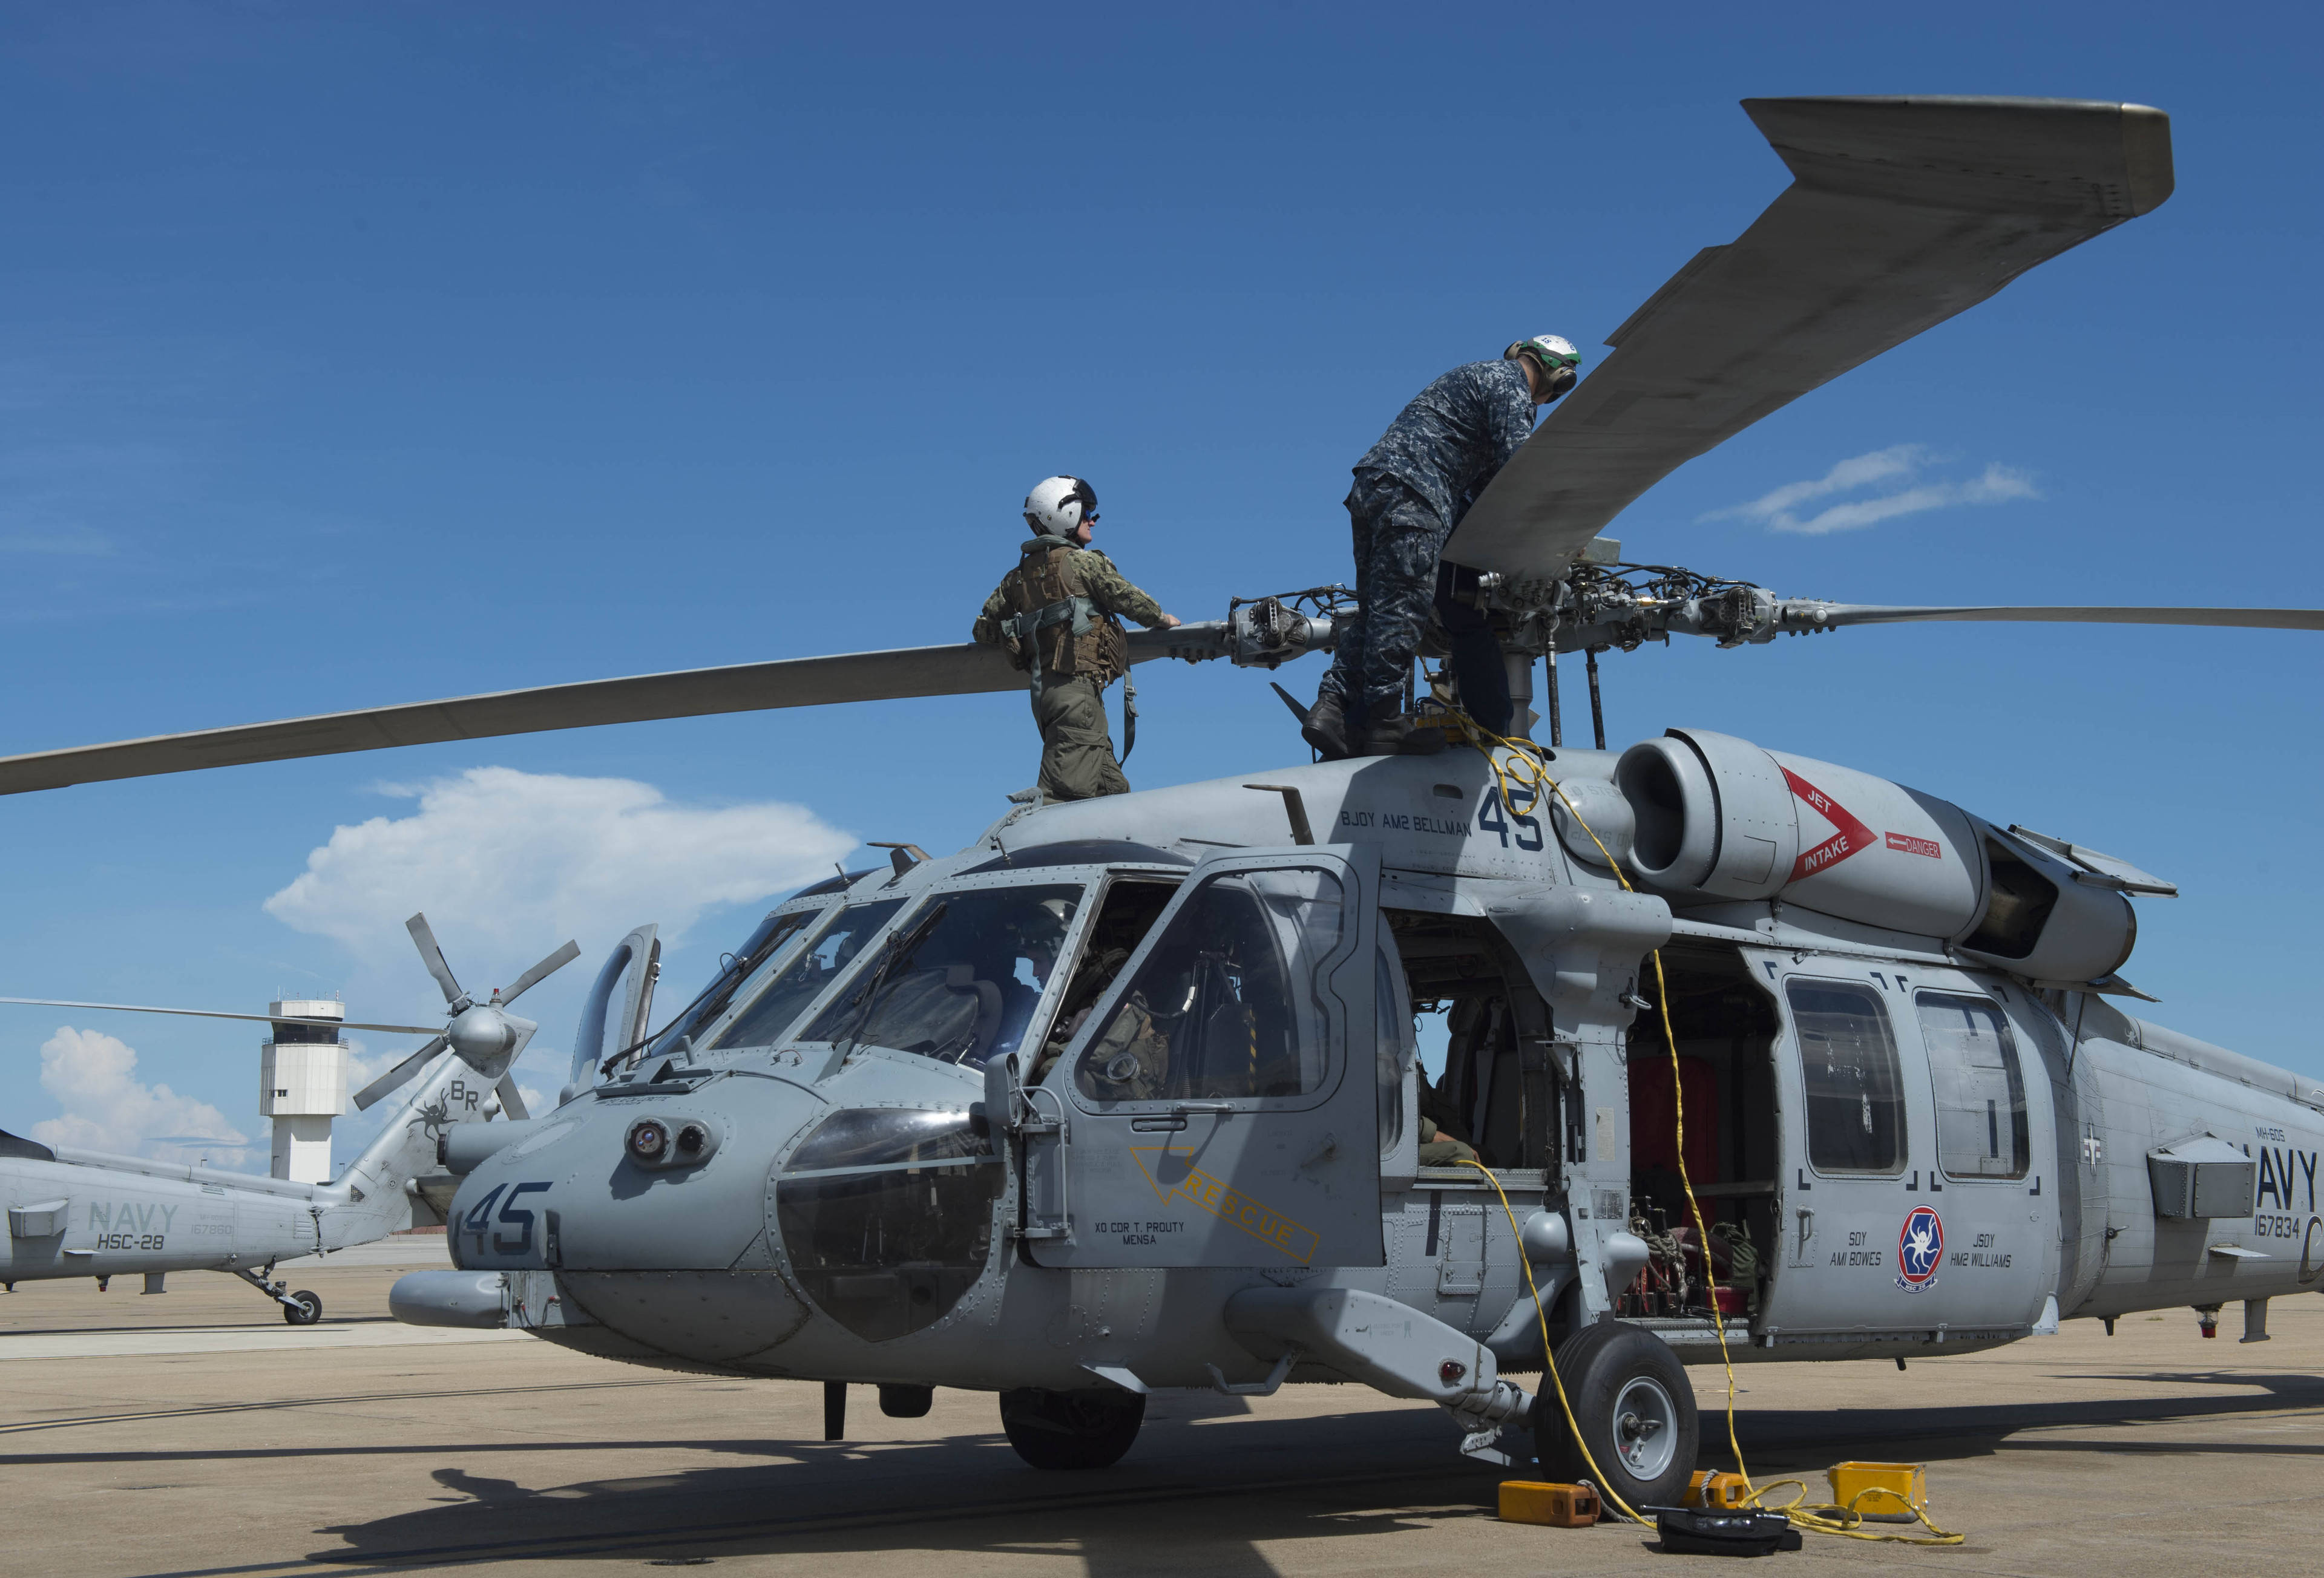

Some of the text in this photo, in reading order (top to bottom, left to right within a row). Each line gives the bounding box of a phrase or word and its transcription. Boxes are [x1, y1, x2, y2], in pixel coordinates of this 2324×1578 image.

[1807, 790, 1831, 813] JET
[1341, 811, 1472, 838] BJOY AM2 BELLMAN
[1477, 785, 1544, 852] 45
[1804, 835, 1850, 872] INTAKE
[1905, 837, 1940, 858] DANGER
[2255, 1126, 2286, 1142] MH-60S
[2227, 1141, 2317, 1213] AVY
[88, 1201, 179, 1234] NAVY
[465, 1181, 554, 1256] 45
[1184, 1173, 1295, 1246] RESCUE
[191, 1223, 233, 1235] 167860
[1094, 1221, 1184, 1233] XO CDR T. PROUTY
[2254, 1214, 2300, 1240] 167834
[97, 1233, 165, 1250] HSC-28
[1123, 1234, 1157, 1245] MENSA
[1848, 1231, 1868, 1246] SOY
[1972, 1233, 1995, 1248] JSOY
[1848, 1251, 1882, 1266] BOWES
[1950, 1252, 2012, 1268] HM2 WILLIAMS
